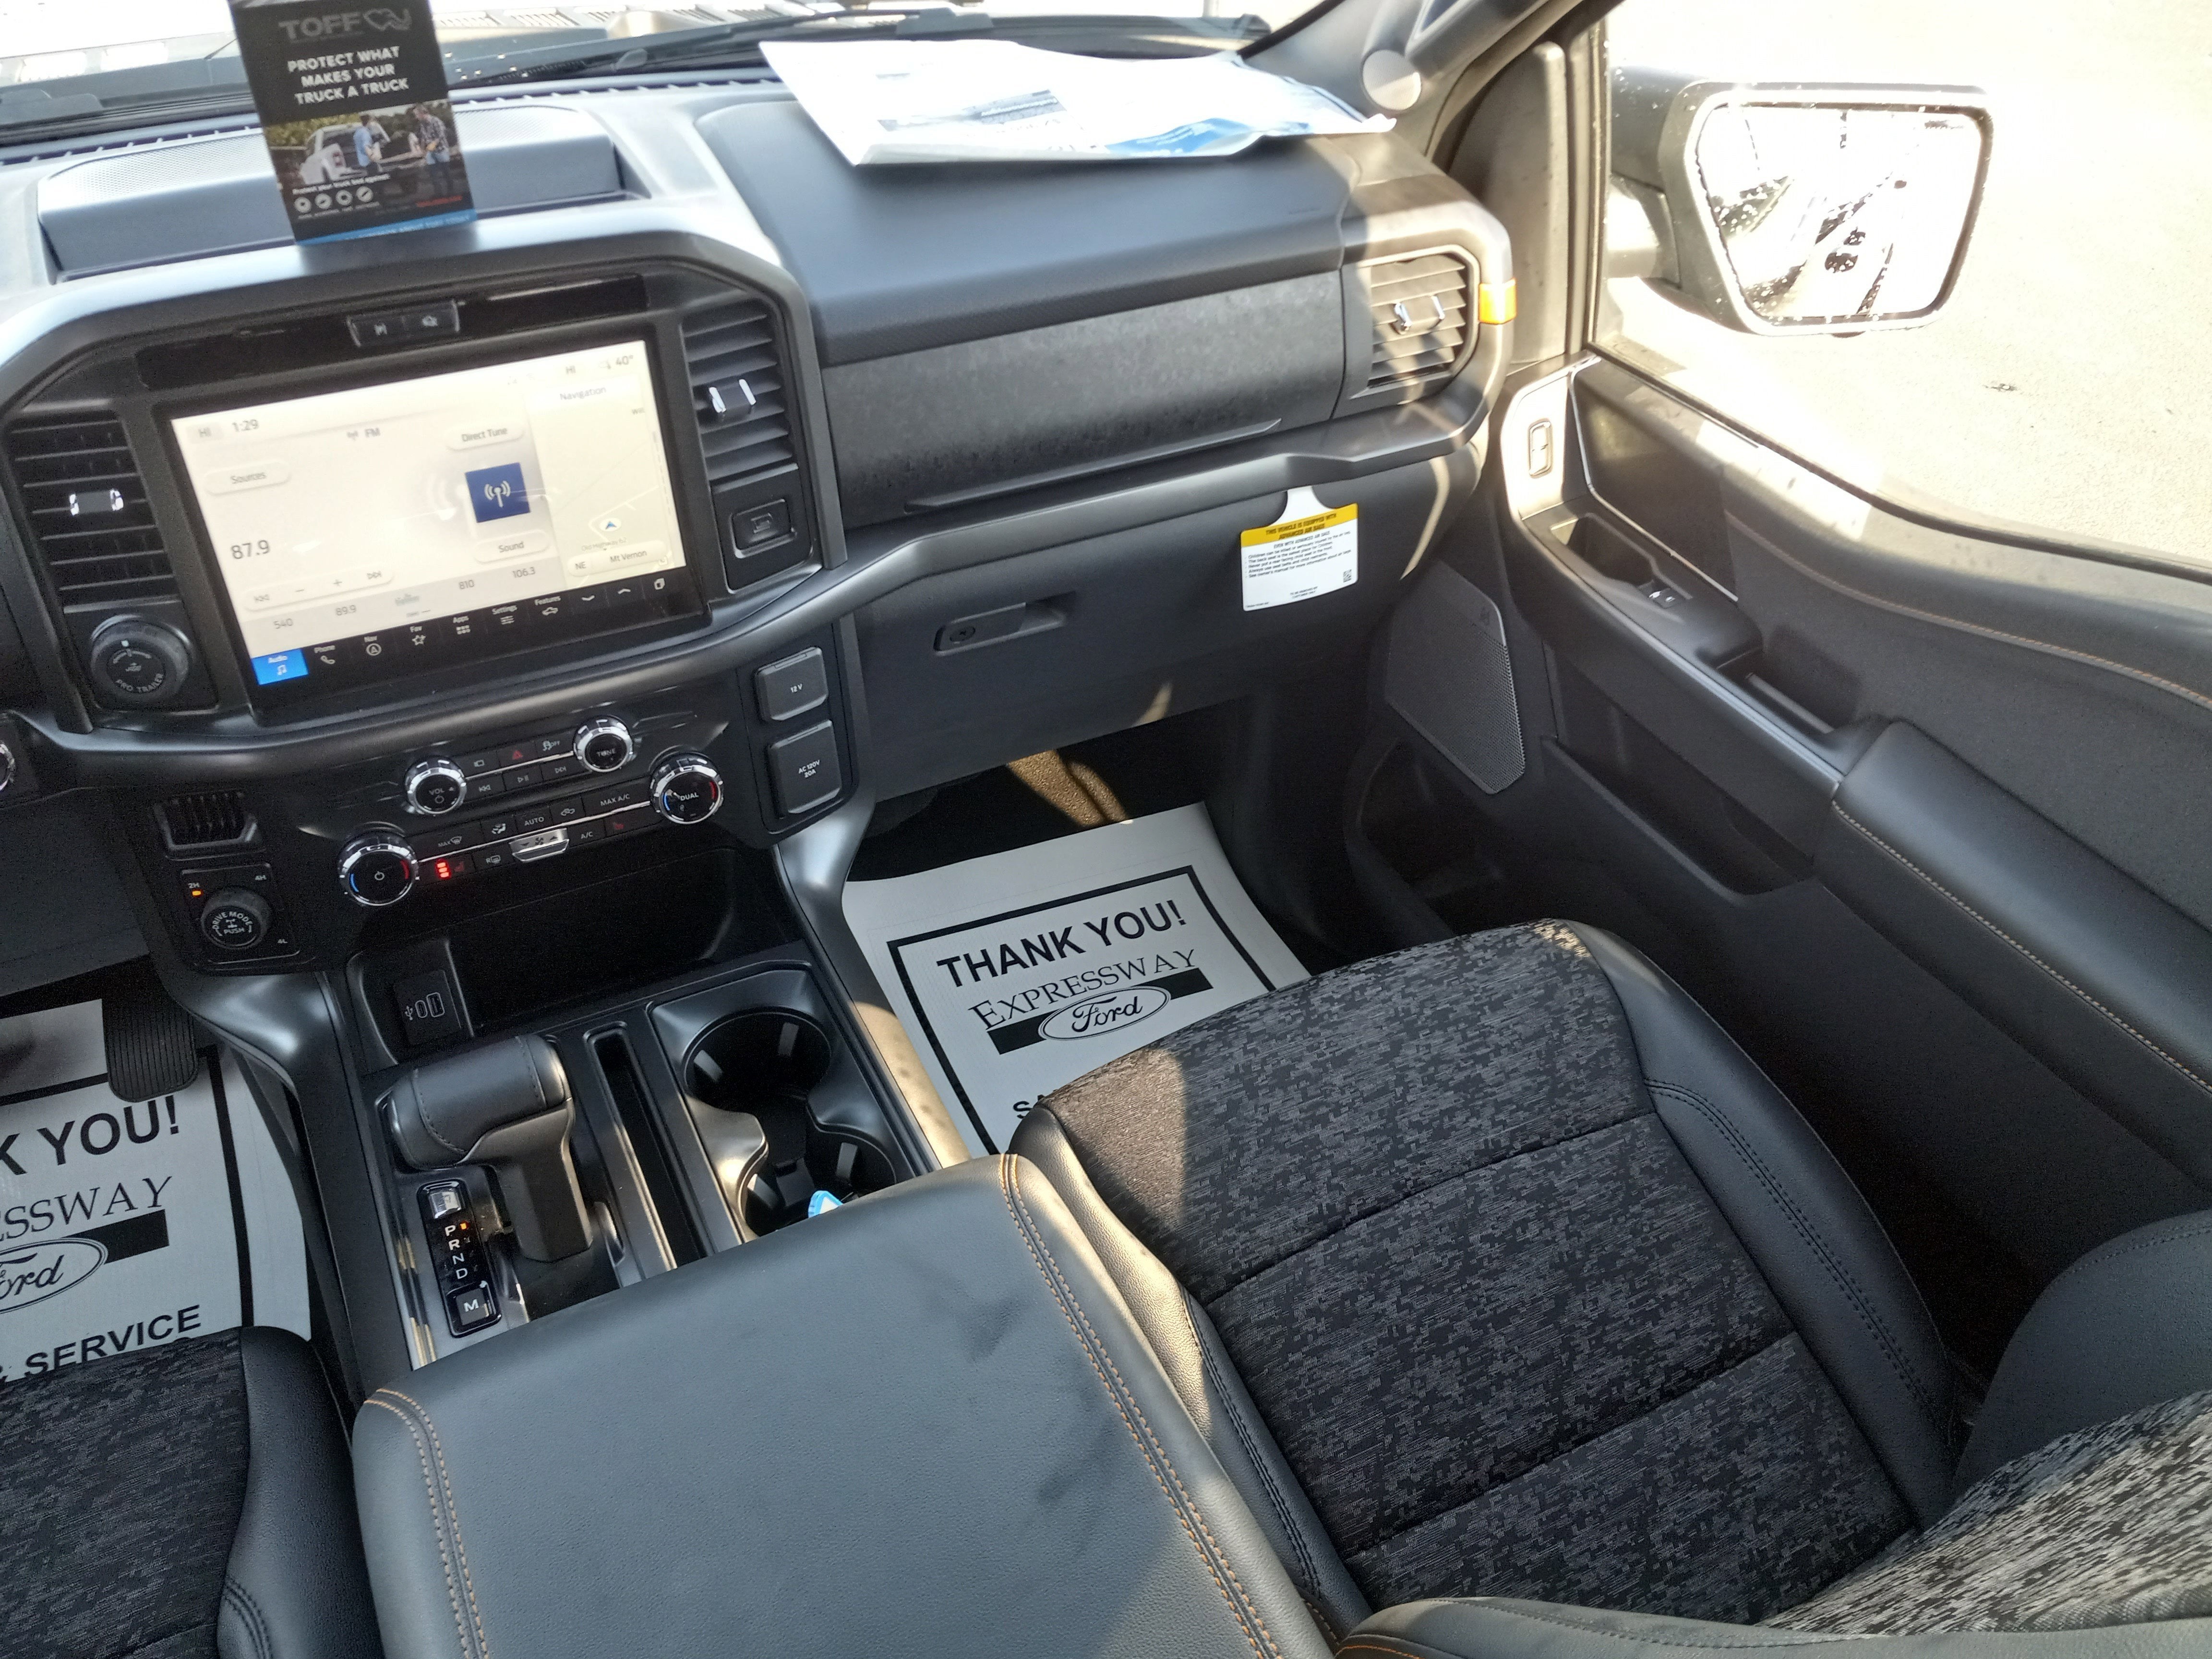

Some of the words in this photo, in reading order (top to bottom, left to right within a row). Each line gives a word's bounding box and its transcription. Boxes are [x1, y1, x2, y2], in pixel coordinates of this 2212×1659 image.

[288, 52, 354, 73] PROTECT
[357, 46, 400, 63] WHAT
[301, 70, 352, 88] MAKES
[353, 63, 395, 80] YOUR
[294, 87, 345, 105] TRUCK
[348, 85, 360, 98] A
[361, 78, 409, 95] TRUCK
[560, 387, 606, 399] Navigation
[232, 419, 260, 432] 1:29
[364, 427, 381, 438] FM
[461, 428, 485, 442] Direct
[487, 426, 507, 437] Tune
[230, 472, 267, 484] Sources
[230, 539, 271, 560] 87.9
[498, 540, 524, 553] Sound
[610, 555, 620, 563] Mt
[621, 551, 647, 560] Vernon
[575, 561, 587, 570] NE
[512, 567, 536, 578] 106.3
[459, 579, 475, 590] 810
[534, 596, 561, 606] Features
[336, 605, 357, 616] 89.9
[492, 605, 517, 615] Settings
[273, 618, 294, 629] 540
[313, 645, 336, 653] Phone
[268, 655, 288, 664] Audio
[798, 766, 806, 774] AC
[806, 759, 820, 770] 120V
[804, 769, 816, 778] 20A
[601, 797, 616, 807] MAX
[617, 793, 630, 802] A/C
[680, 792, 699, 801] DUAL
[524, 816, 545, 826] AUTO
[580, 831, 593, 840] A/C
[212, 912, 228, 930] DRIVE
[229, 911, 253, 926] MODE
[937, 925, 1086, 988] THANK
[1085, 899, 1187, 947] YOU!
[968, 949, 1198, 1031] EXPRESSWAY
[1070, 996, 1144, 1034] Ford
[37, 1094, 180, 1166] YOU!
[0, 1176, 172, 1241] SSWAY
[445, 1225, 456, 1237] P
[448, 1238, 461, 1250] R
[452, 1252, 465, 1265] N
[456, 1268, 468, 1280] D
[463, 1298, 479, 1312] M
[24, 1304, 202, 1377] SERVICE
